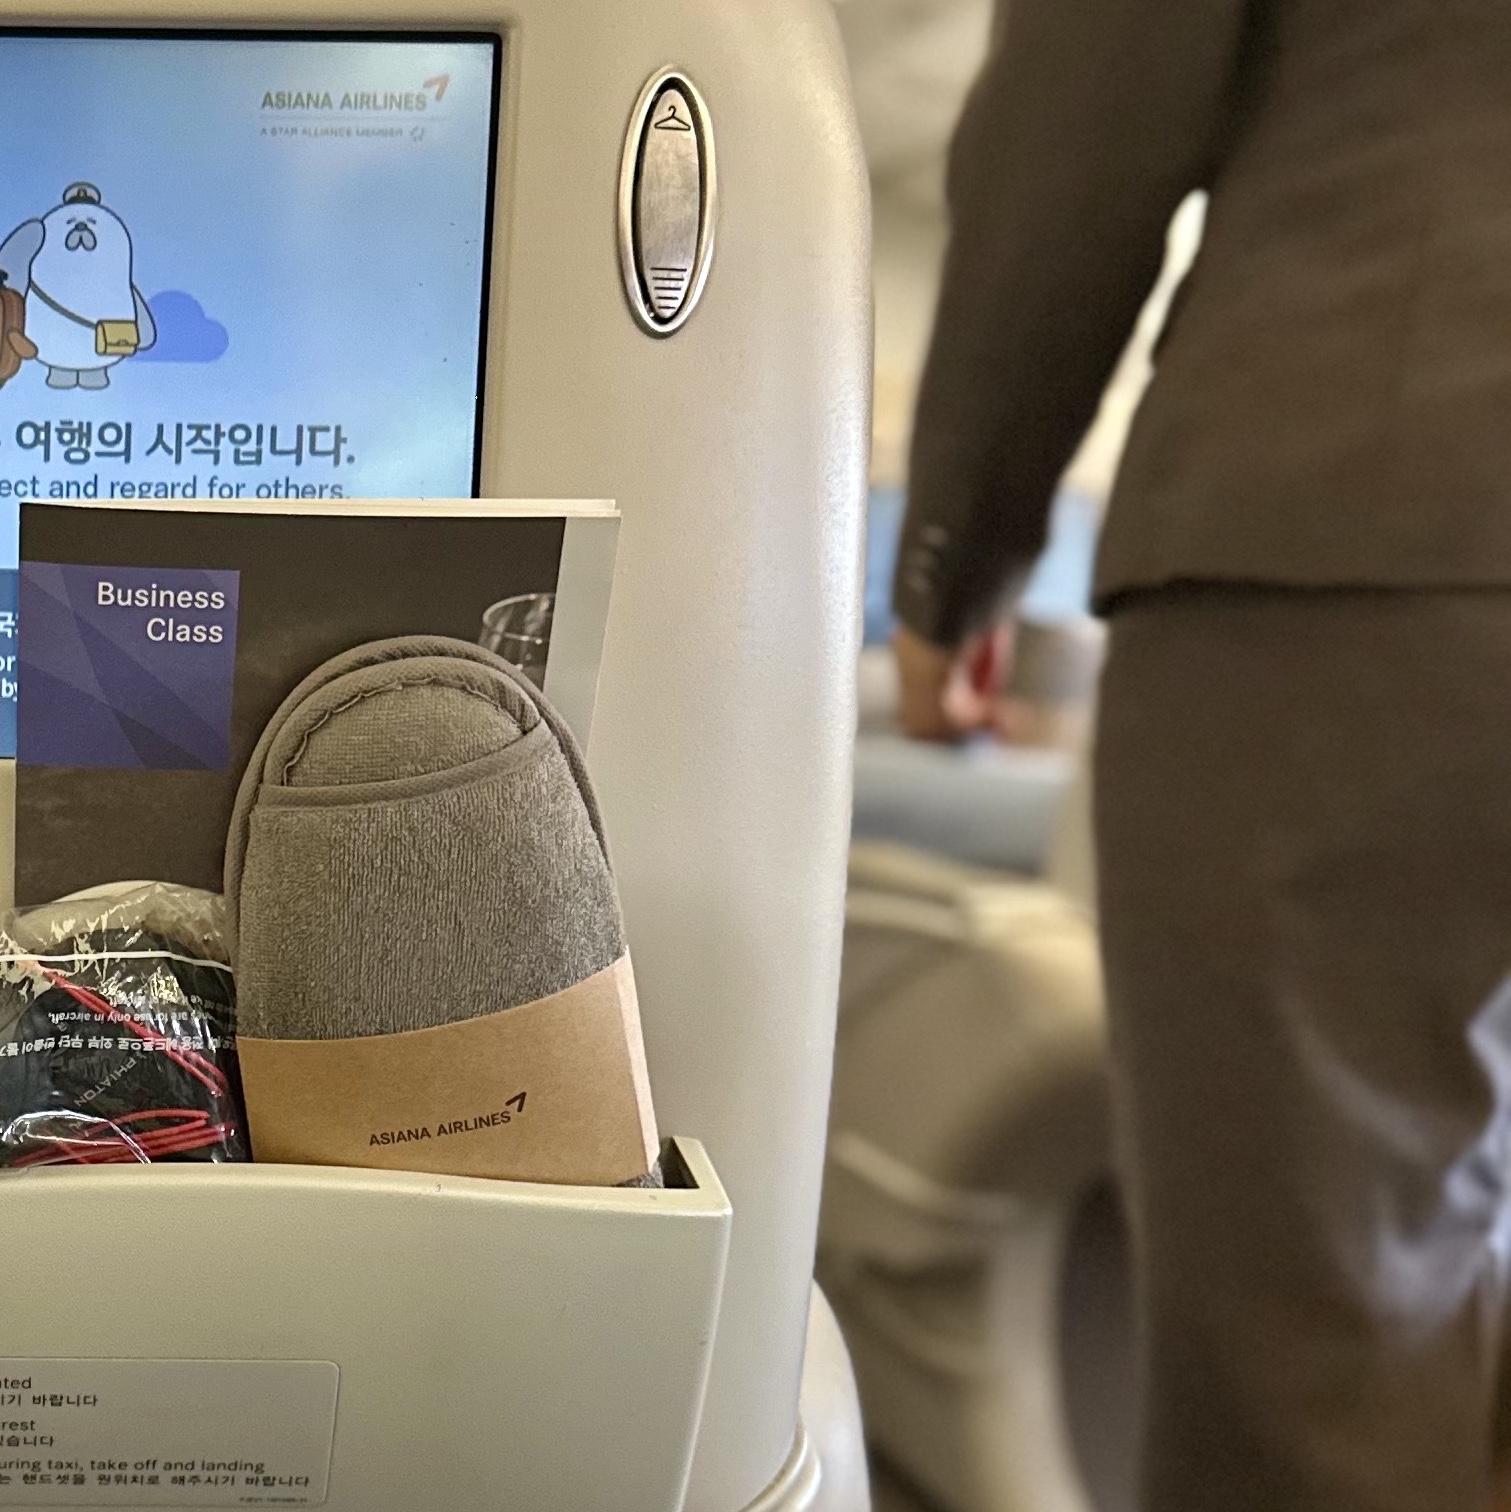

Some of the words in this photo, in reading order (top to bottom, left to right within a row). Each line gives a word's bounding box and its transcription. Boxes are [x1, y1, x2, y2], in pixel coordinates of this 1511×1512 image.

[261, 91, 334, 111] ASIANA
[340, 91, 428, 112] AIRLINES
[301, 126, 352, 138] ALLIANCE
[15, 419, 133, 465] 여행의
[146, 422, 356, 466] 시작입니다.
[49, 475, 101, 499] and
[110, 475, 198, 499] regard
[207, 476, 246, 499] for
[97, 581, 225, 609] Business
[146, 617, 223, 643] Class
[94, 1013, 105, 1024] in
[107, 1011, 131, 1023] only
[58, 1034, 84, 1048] 무단
[88, 1035, 113, 1050] 외부
[74, 1056, 136, 1108] PHIATON
[369, 1127, 431, 1146] ASIANA
[437, 1110, 511, 1137] AIRLINES
[32, 1394, 99, 1407] 바랍니다
[47, 1459, 84, 1472] taxi,
[90, 1459, 128, 1471] take
[134, 1459, 158, 1471] off
[163, 1459, 195, 1472] and
[201, 1459, 265, 1475] landing
[97, 1474, 160, 1486] 원위치로
[245, 1475, 310, 1488] 바랍니다
